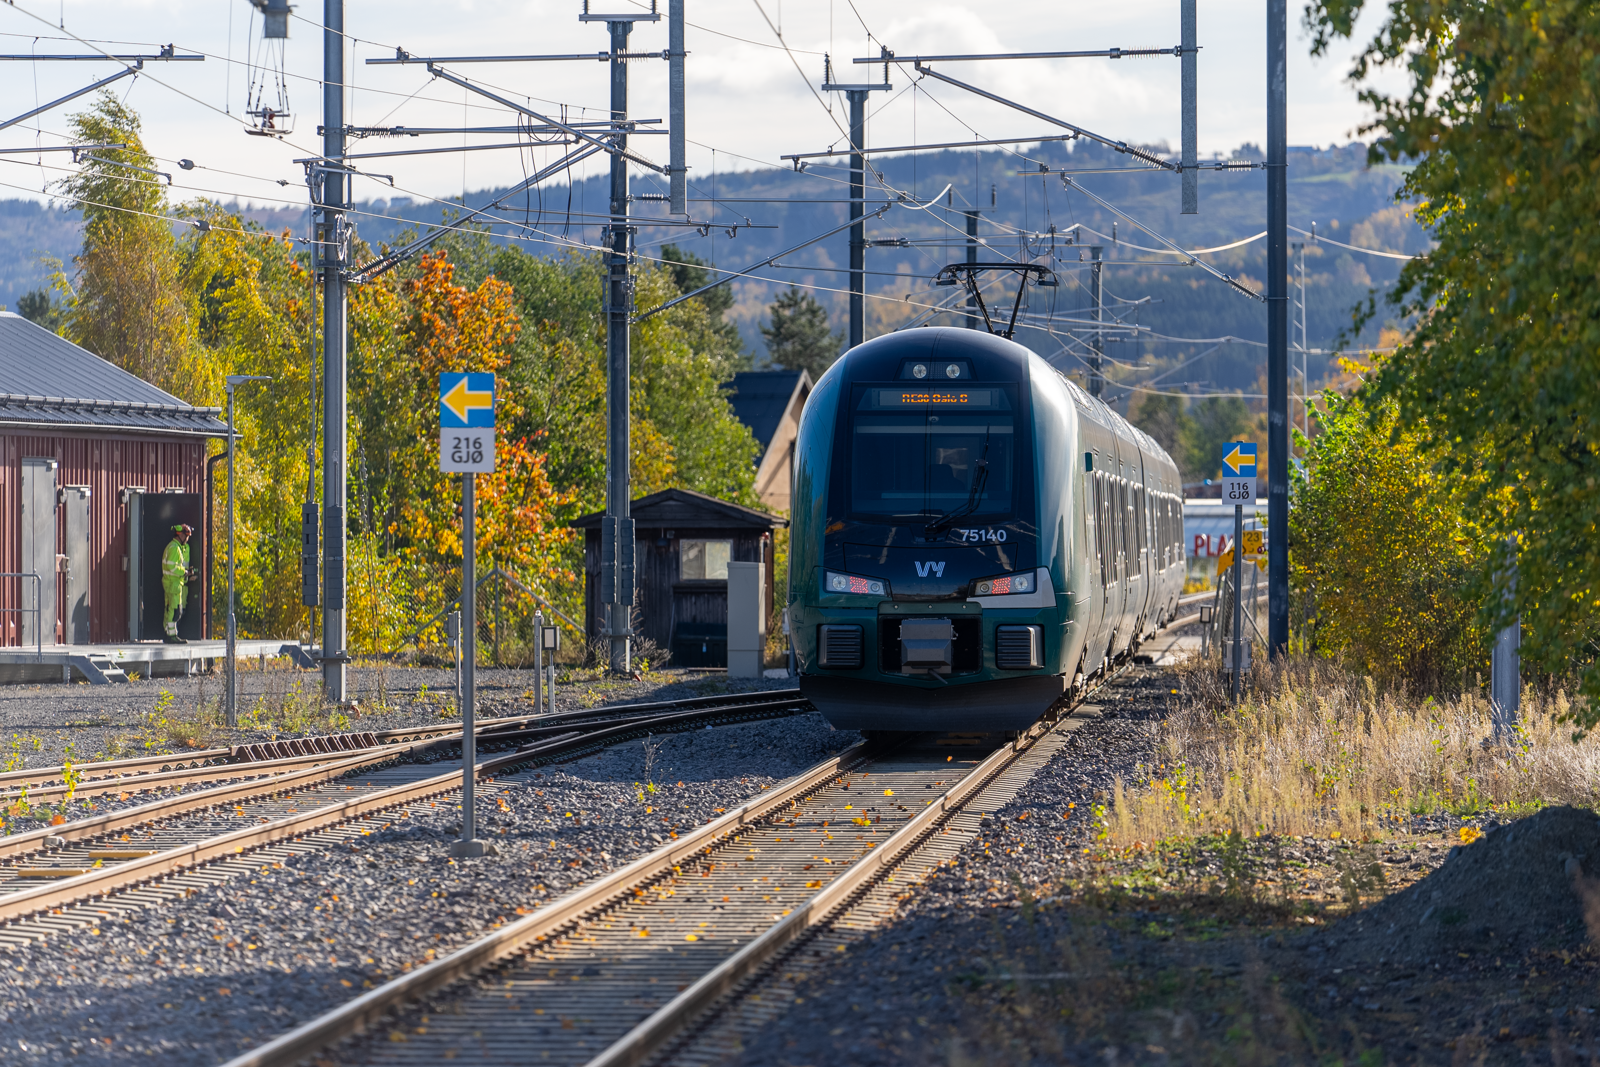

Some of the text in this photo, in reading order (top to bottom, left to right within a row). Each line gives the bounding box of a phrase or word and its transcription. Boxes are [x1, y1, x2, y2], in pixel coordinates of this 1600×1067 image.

[452, 436, 482, 450] 216
[451, 450, 484, 464] GJØ
[1230, 482, 1248, 490] 116
[1229, 490, 1249, 499] GJØ
[960, 529, 1007, 542] 75140
